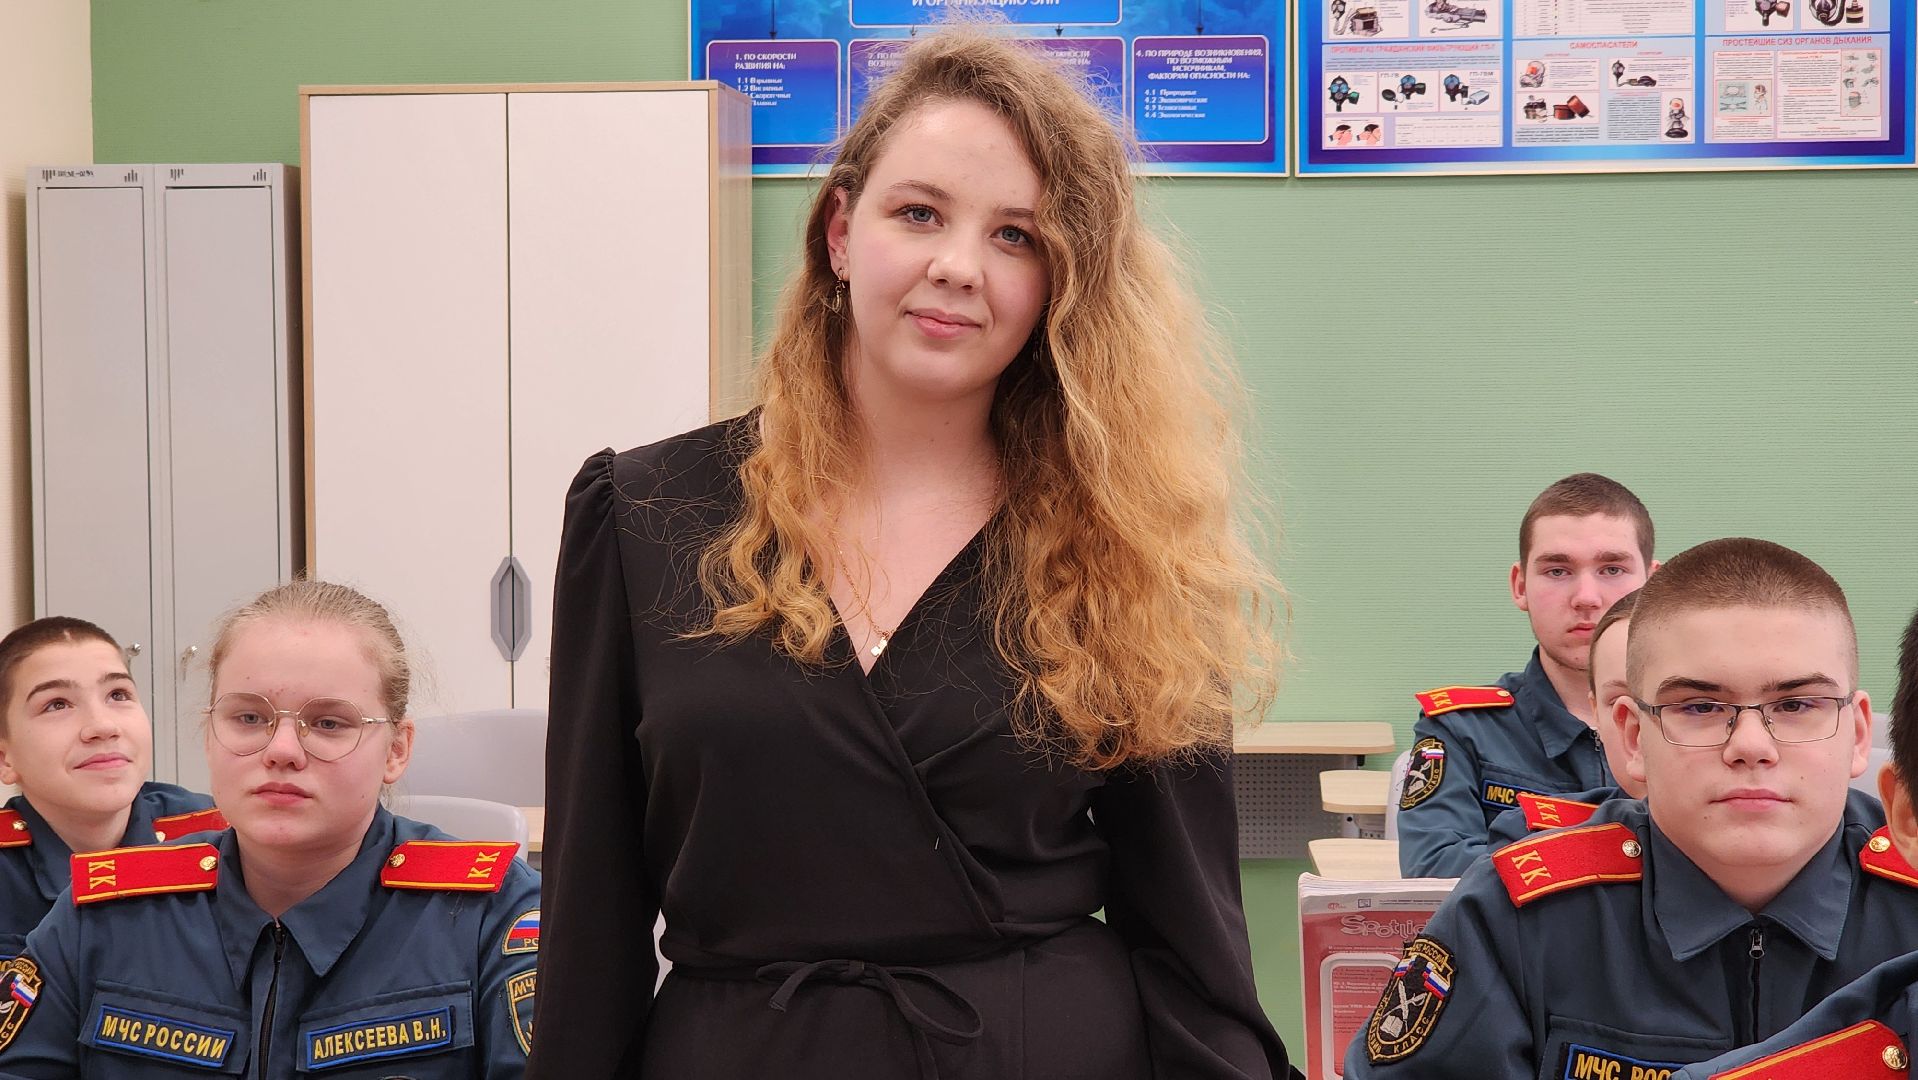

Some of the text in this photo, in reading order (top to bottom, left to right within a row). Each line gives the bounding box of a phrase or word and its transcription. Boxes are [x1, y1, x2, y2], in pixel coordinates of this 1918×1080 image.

[1569, 40, 1638, 49] САМОСПАСАТЕЛИ
[1723, 36, 1873, 47] ПРОСТЕЙШИЕ СИЗ ОРГАНОВ ДЫХАНИЯ
[744, 53, 756, 61] ПО
[757, 53, 797, 61] СКОРОСТИ
[1145, 49, 1157, 57] ПО
[1158, 49, 1193, 58] ПРИРОДЕ
[1167, 57, 1233, 65] ПО ВОЗМОЖНЫМ
[735, 62, 772, 70] РАЗВИТИЯ
[1189, 72, 1237, 80] ОПАСНОСТИ
[1430, 691, 1453, 708] КК
[1486, 785, 1515, 805] МЧС
[1535, 801, 1562, 824] КК
[88, 859, 117, 890] КК
[467, 851, 501, 879] КК
[1511, 849, 1552, 887] КК
[513, 977, 537, 998] МЧ
[101, 1015, 227, 1059] МЧС РОССИИ
[314, 1017, 447, 1060] АЛЕКСЕЕВА В.Н.
[1393, 1016, 1430, 1054] КЛАСС
[1574, 1053, 1621, 1080] МЧС
